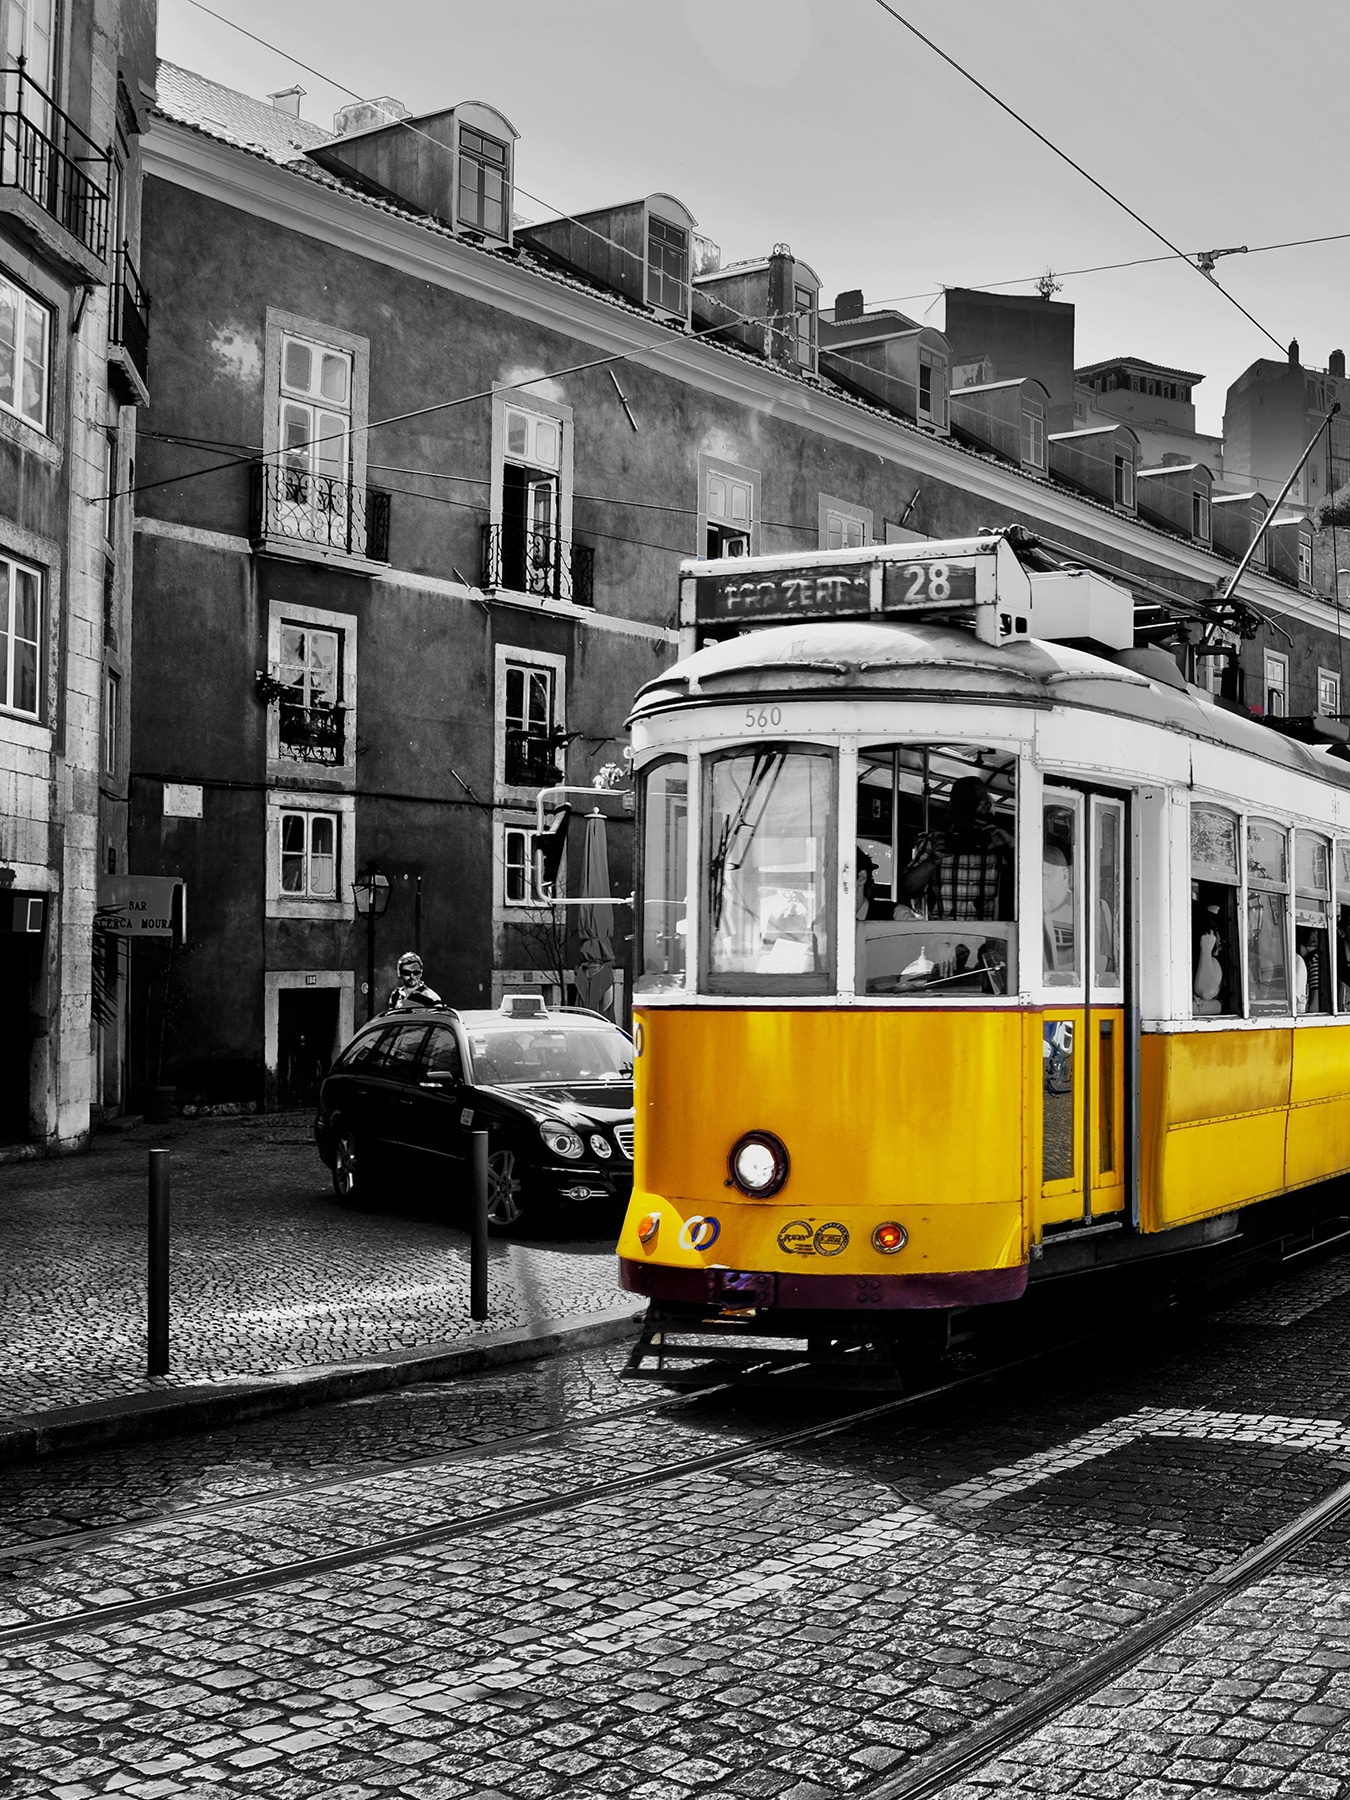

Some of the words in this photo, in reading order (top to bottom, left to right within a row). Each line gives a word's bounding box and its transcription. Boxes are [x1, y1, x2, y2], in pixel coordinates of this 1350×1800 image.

[903, 563, 951, 601] 28
[745, 706, 782, 728] 560
[128, 901, 147, 911] BAR
